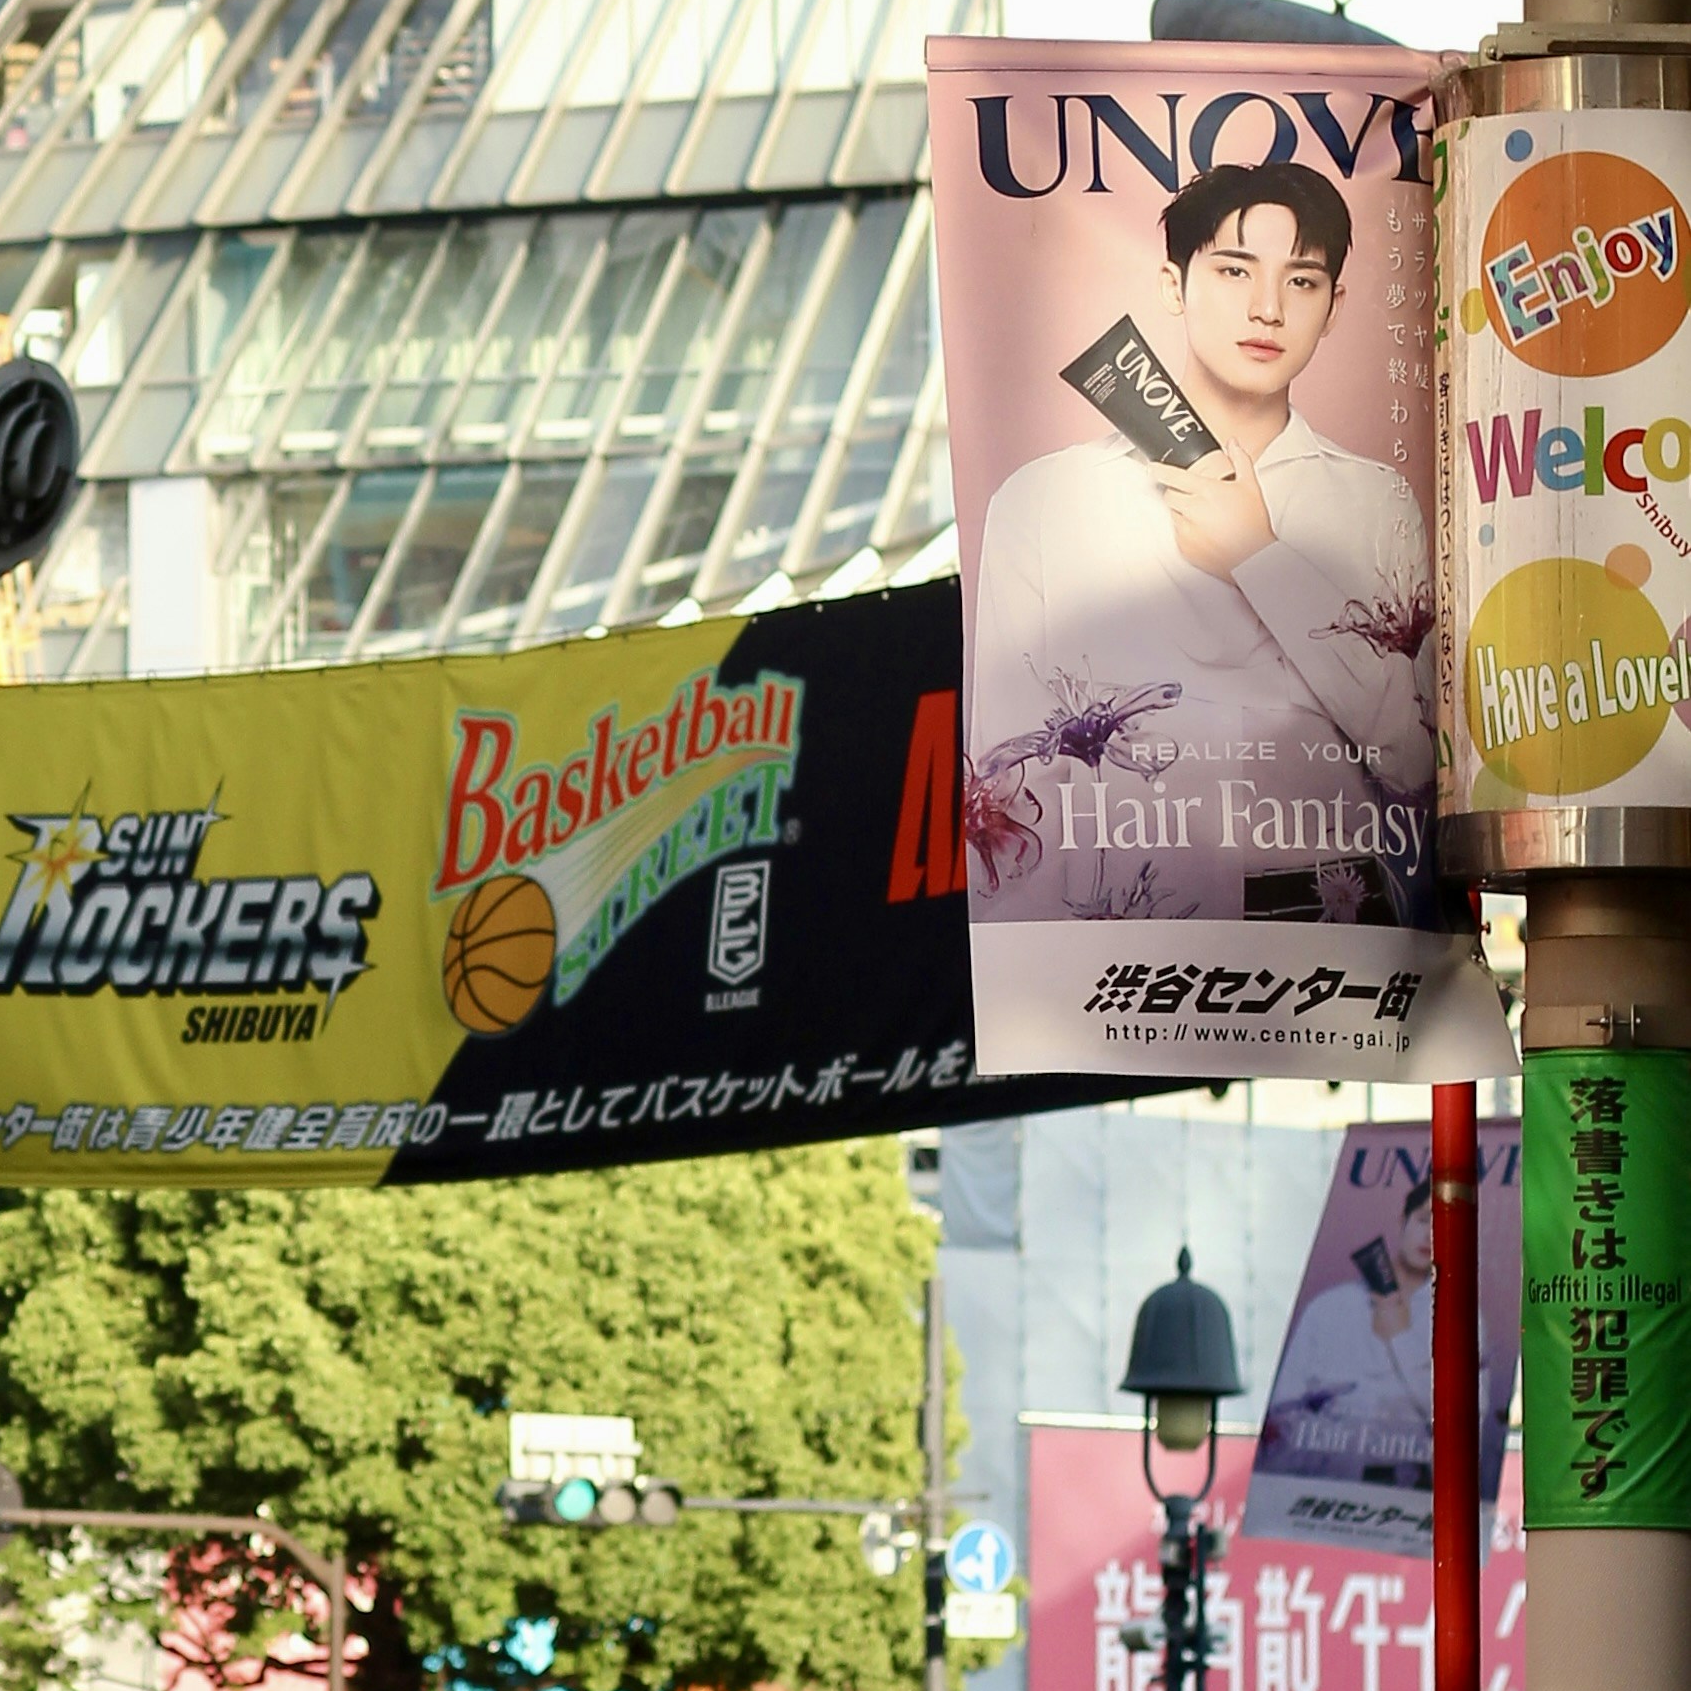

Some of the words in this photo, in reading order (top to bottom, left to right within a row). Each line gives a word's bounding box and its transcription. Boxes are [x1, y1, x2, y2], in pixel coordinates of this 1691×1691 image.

[1486, 207, 1676, 346] Enjoy
[1115, 339, 1203, 442] UNOVE
[1386, 209, 1412, 575] もう夢で終わらせな
[1466, 406, 1691, 504] Welco
[1475, 644, 1560, 751] Have
[1564, 660, 1589, 724] a
[1590, 638, 1691, 717] Lovel
[433, 671, 798, 895] Basketball
[887, 689, 967, 904] A
[1131, 741, 1276, 762] REALIZE
[1300, 741, 1382, 765] YOUR
[97, 812, 209, 878] SUN
[1056, 780, 1201, 851] Hair
[1218, 779, 1429, 876] Fantasy
[556, 761, 790, 1001] STREET
[181, 1005, 318, 1044] SHIBUYA
[1083, 963, 1422, 1021] 渋谷センター街
[1528, 1275, 1589, 1304] Graffiti
[1596, 1276, 1613, 1303] is
[1619, 1274, 1683, 1305] illegal
